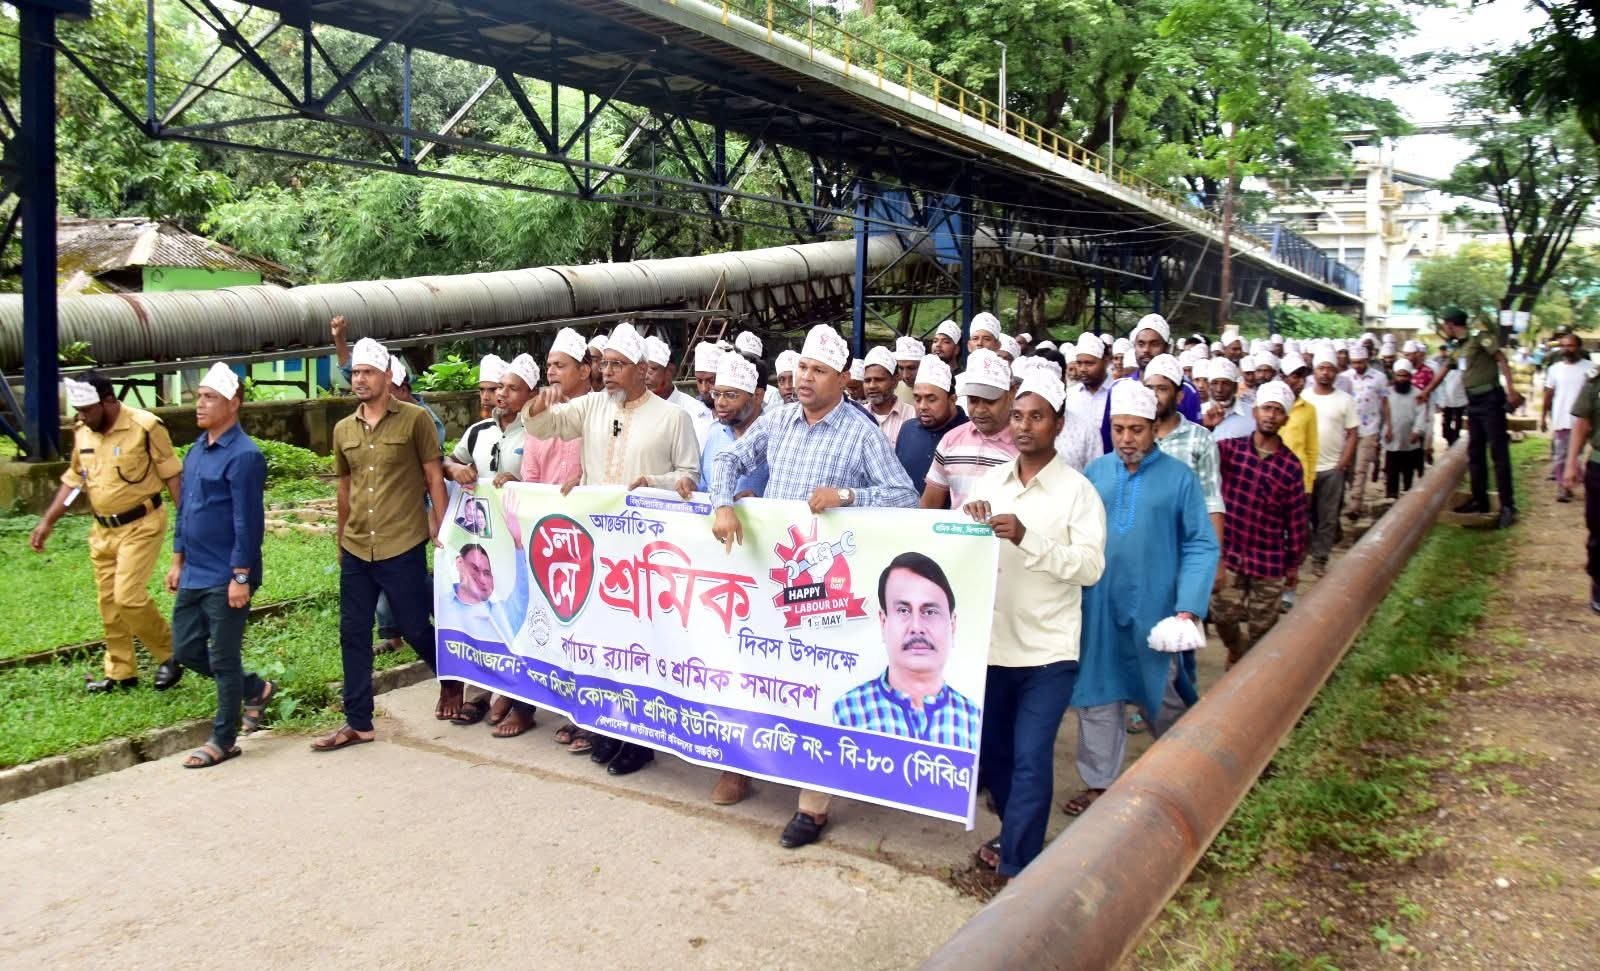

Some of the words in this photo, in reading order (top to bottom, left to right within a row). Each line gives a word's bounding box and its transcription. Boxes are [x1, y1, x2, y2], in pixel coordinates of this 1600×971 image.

[540, 525, 582, 560] ১লা
[548, 562, 580, 611] মে
[599, 541, 757, 634] শ্রমিক
[788, 586, 820, 600] HAPPY
[794, 601, 830, 613] LABOUR
[833, 598, 849, 608] DAY
[822, 615, 841, 625] MAY
[738, 627, 783, 661] দিবস
[788, 634, 859, 672] উপলক্ষে
[655, 658, 667, 677] ও
[671, 657, 732, 692] শ্রমিক
[739, 672, 821, 710] সমাবেশ
[643, 696, 678, 727] শ্রমিক
[680, 705, 748, 748] ইউনিয়ন
[753, 723, 797, 755] রেজি
[838, 736, 894, 774] বি-৮০
